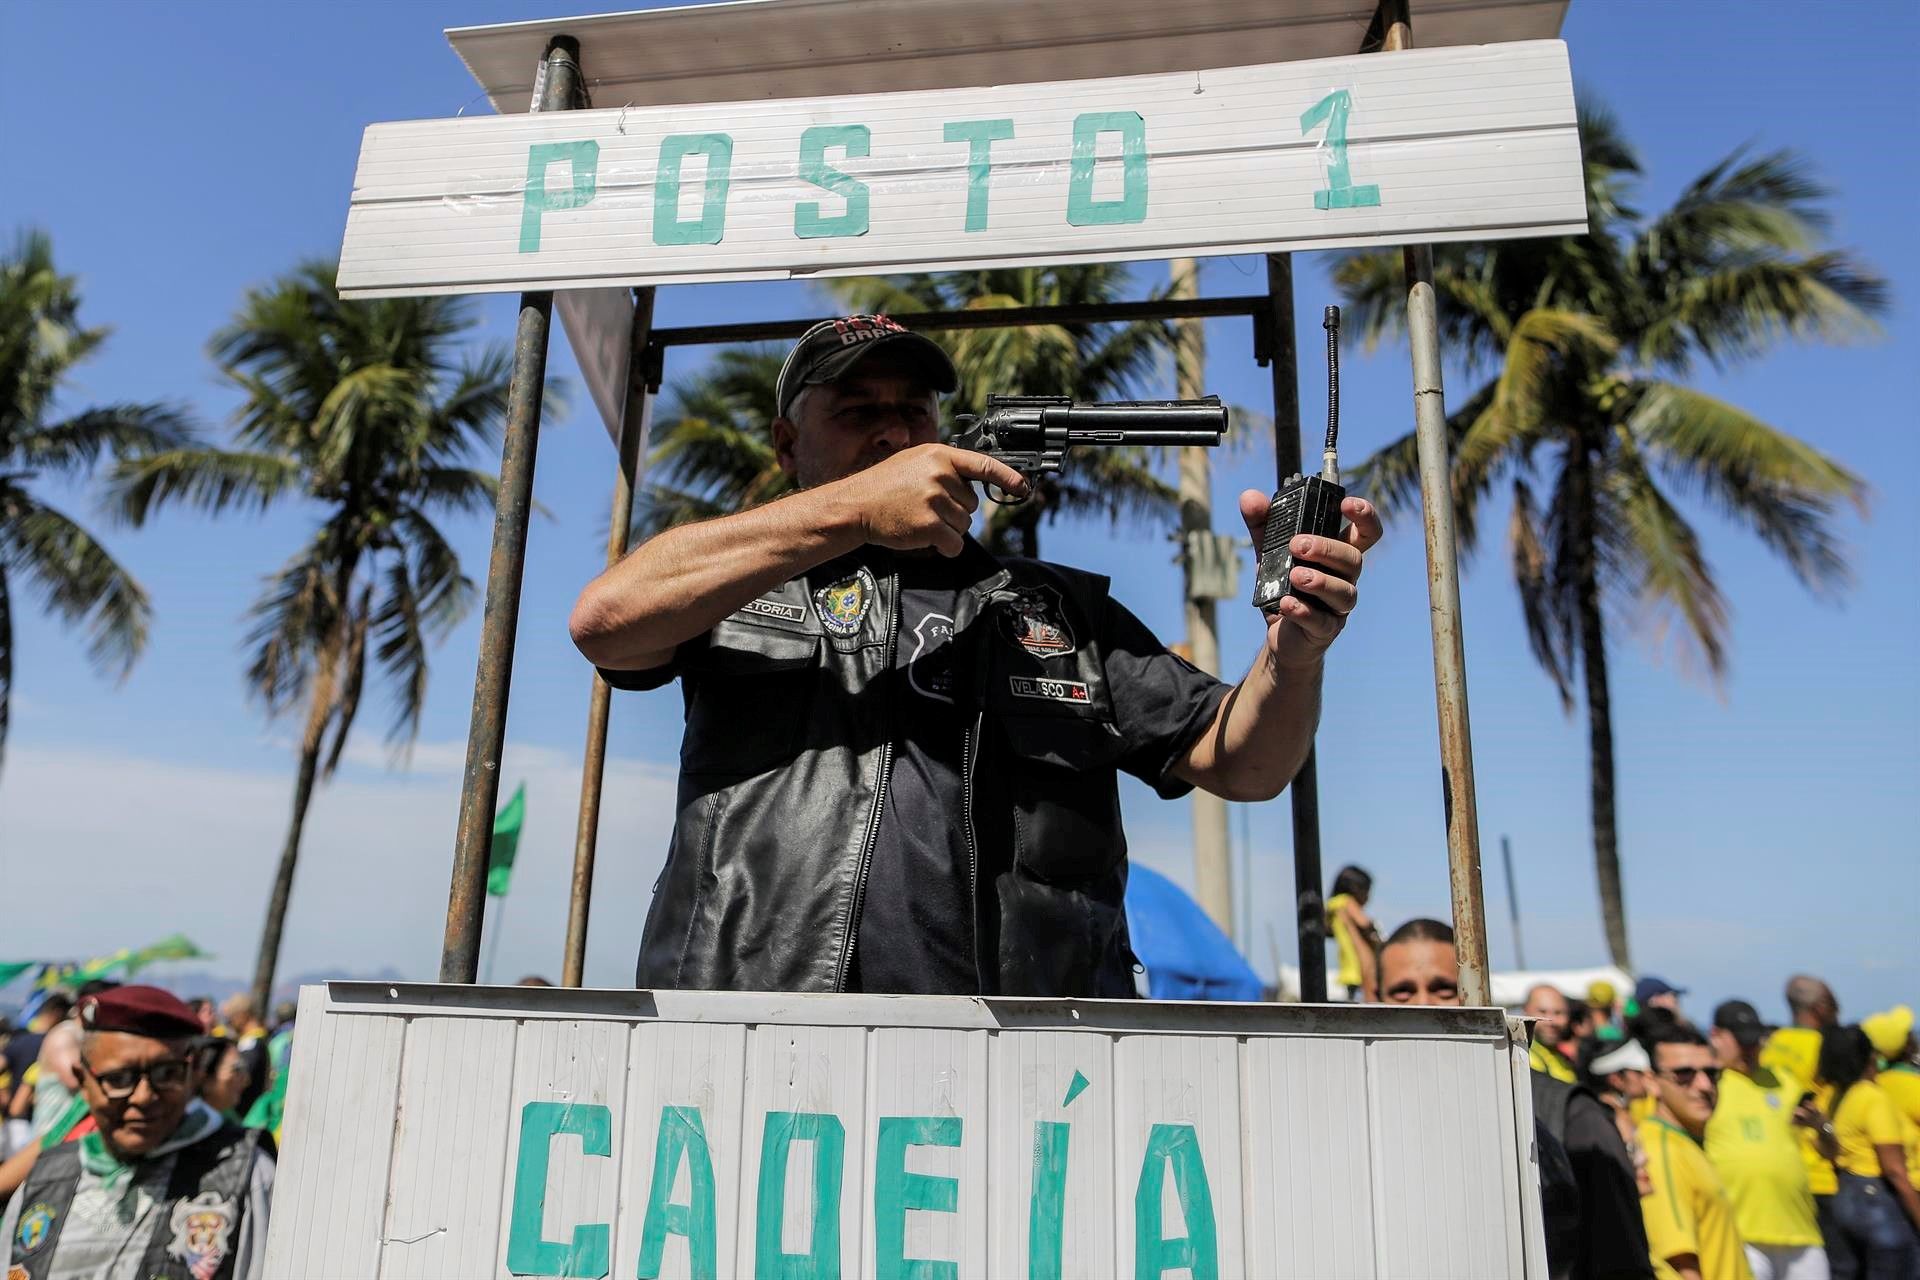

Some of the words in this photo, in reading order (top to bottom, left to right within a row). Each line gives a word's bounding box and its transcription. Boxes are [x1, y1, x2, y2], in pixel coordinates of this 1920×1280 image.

[518, 111, 1148, 253] POSTO
[1300, 88, 1381, 211] 1
[1013, 680, 1065, 698] VELASCO
